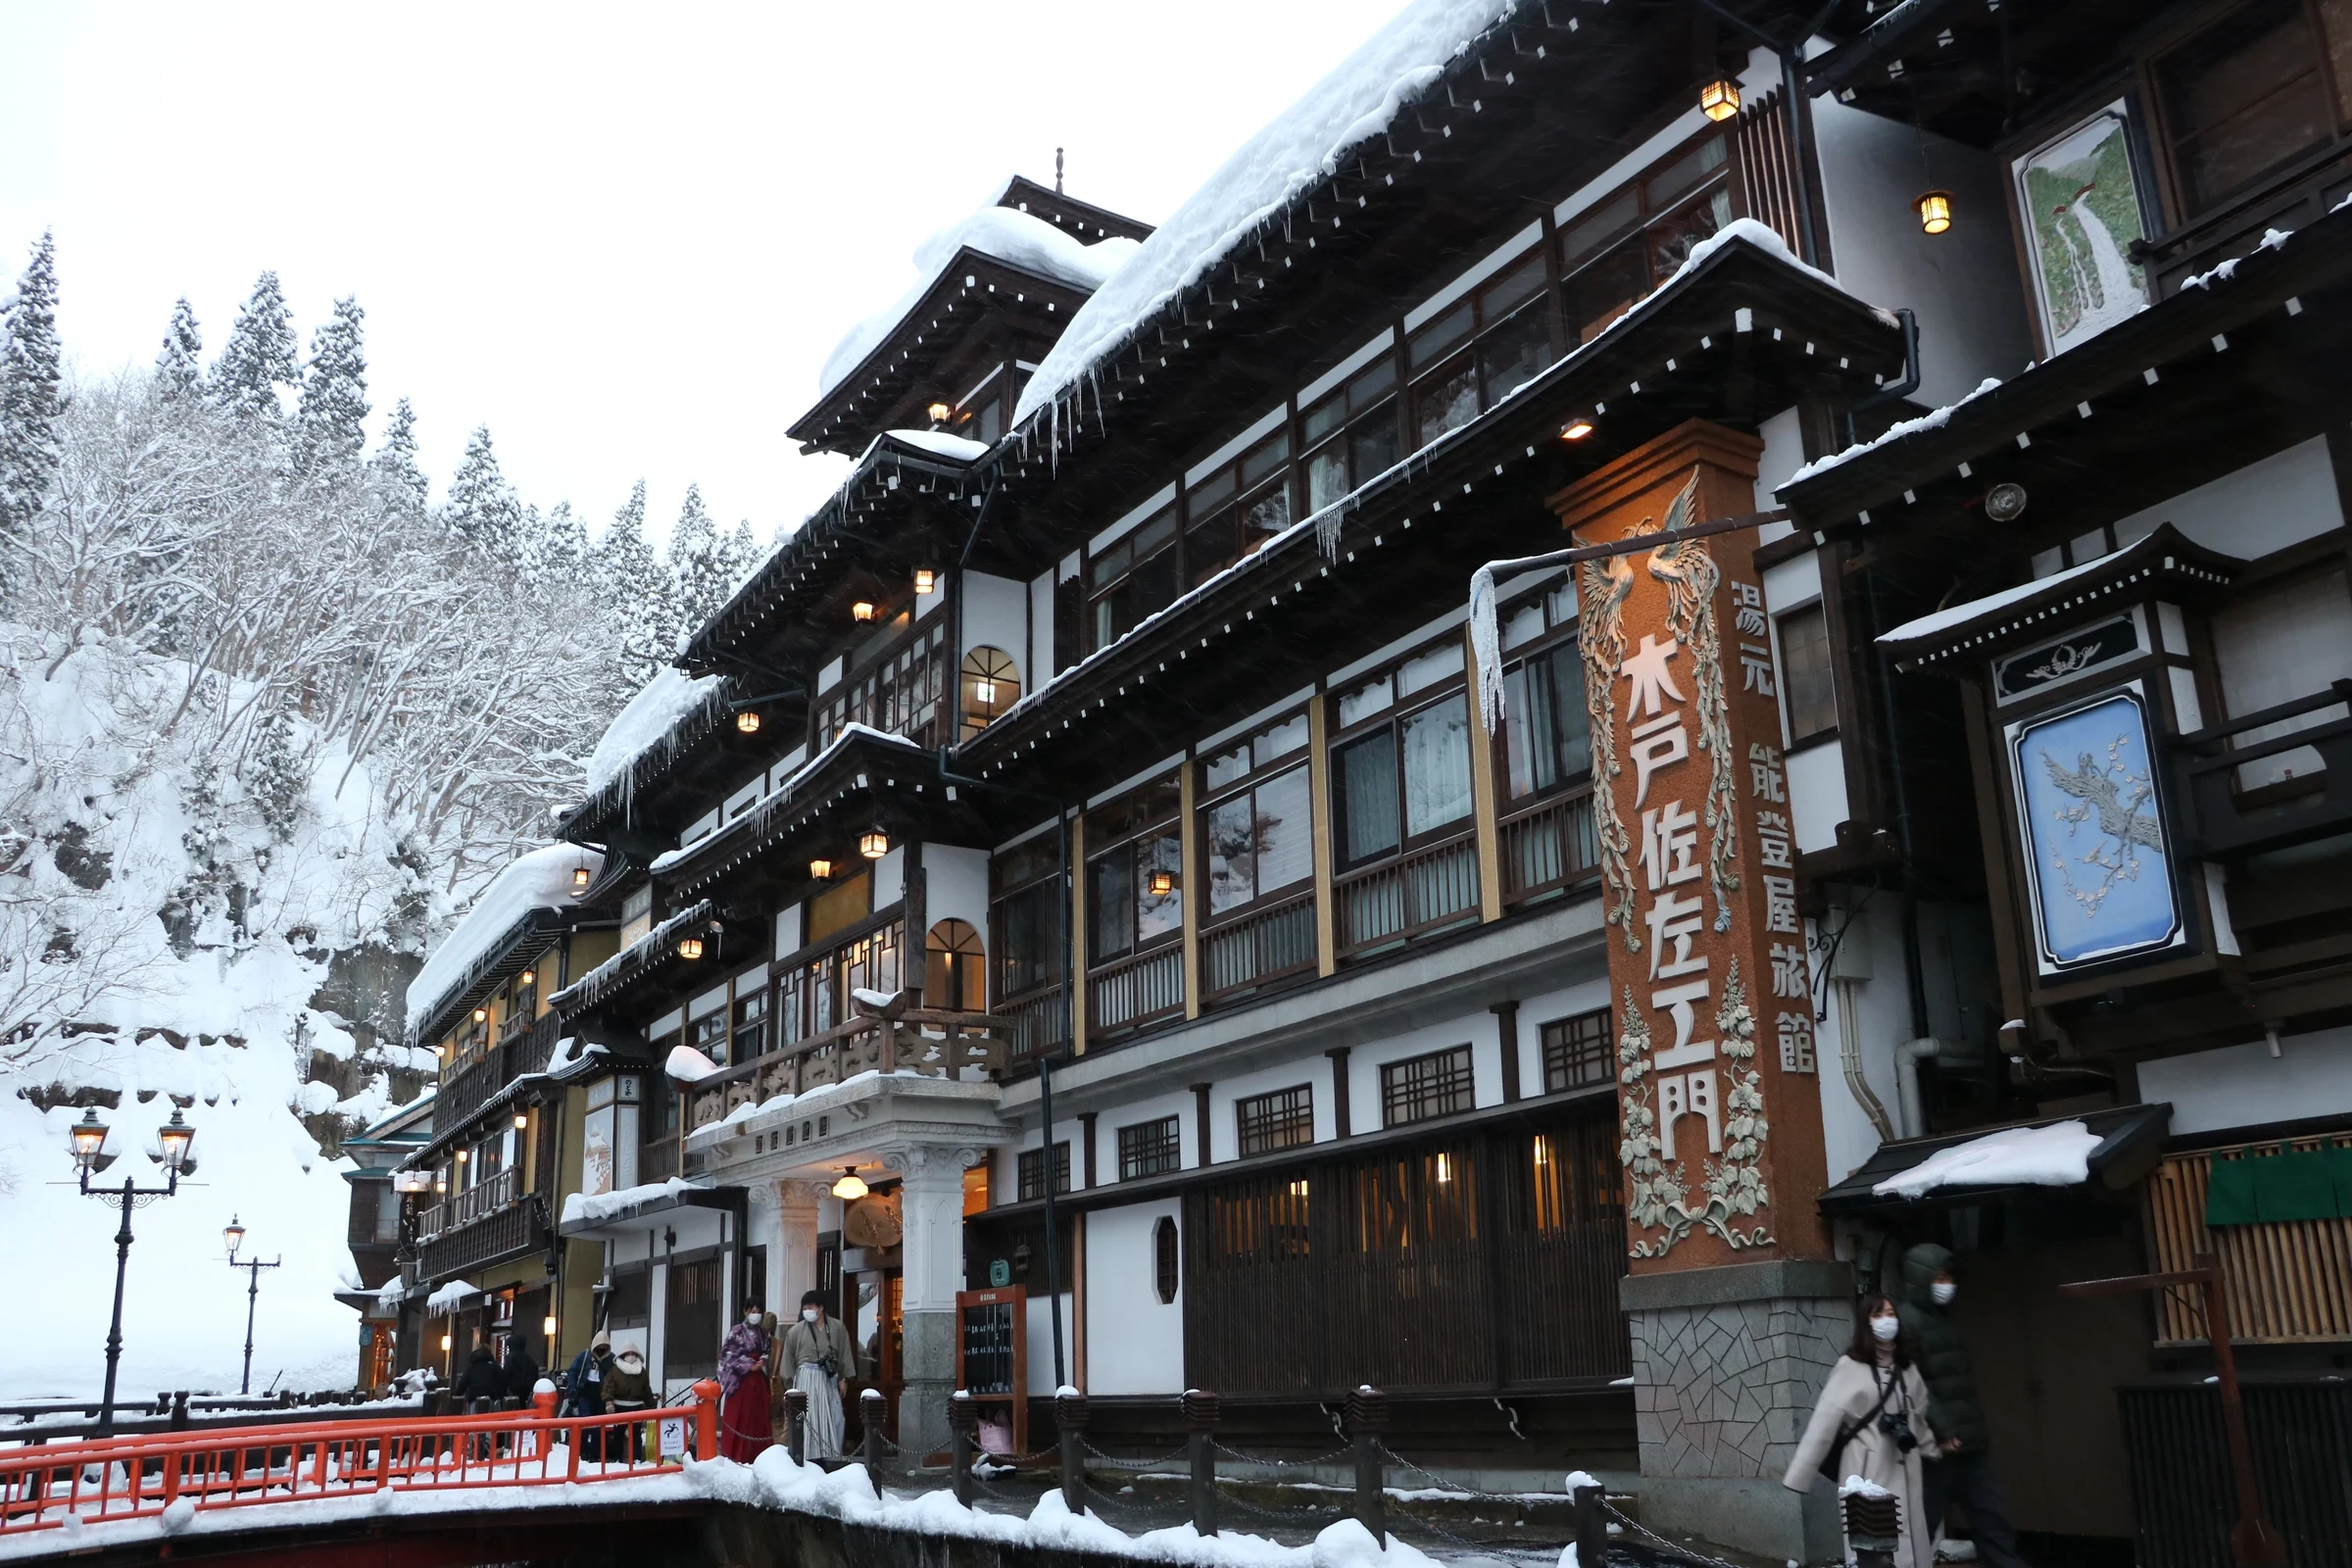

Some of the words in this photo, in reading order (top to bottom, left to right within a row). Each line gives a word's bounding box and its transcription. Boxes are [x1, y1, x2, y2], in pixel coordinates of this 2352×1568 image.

[1732, 580, 1774, 697] 湯元
[1748, 743, 1815, 1073] 能登屋旅館
